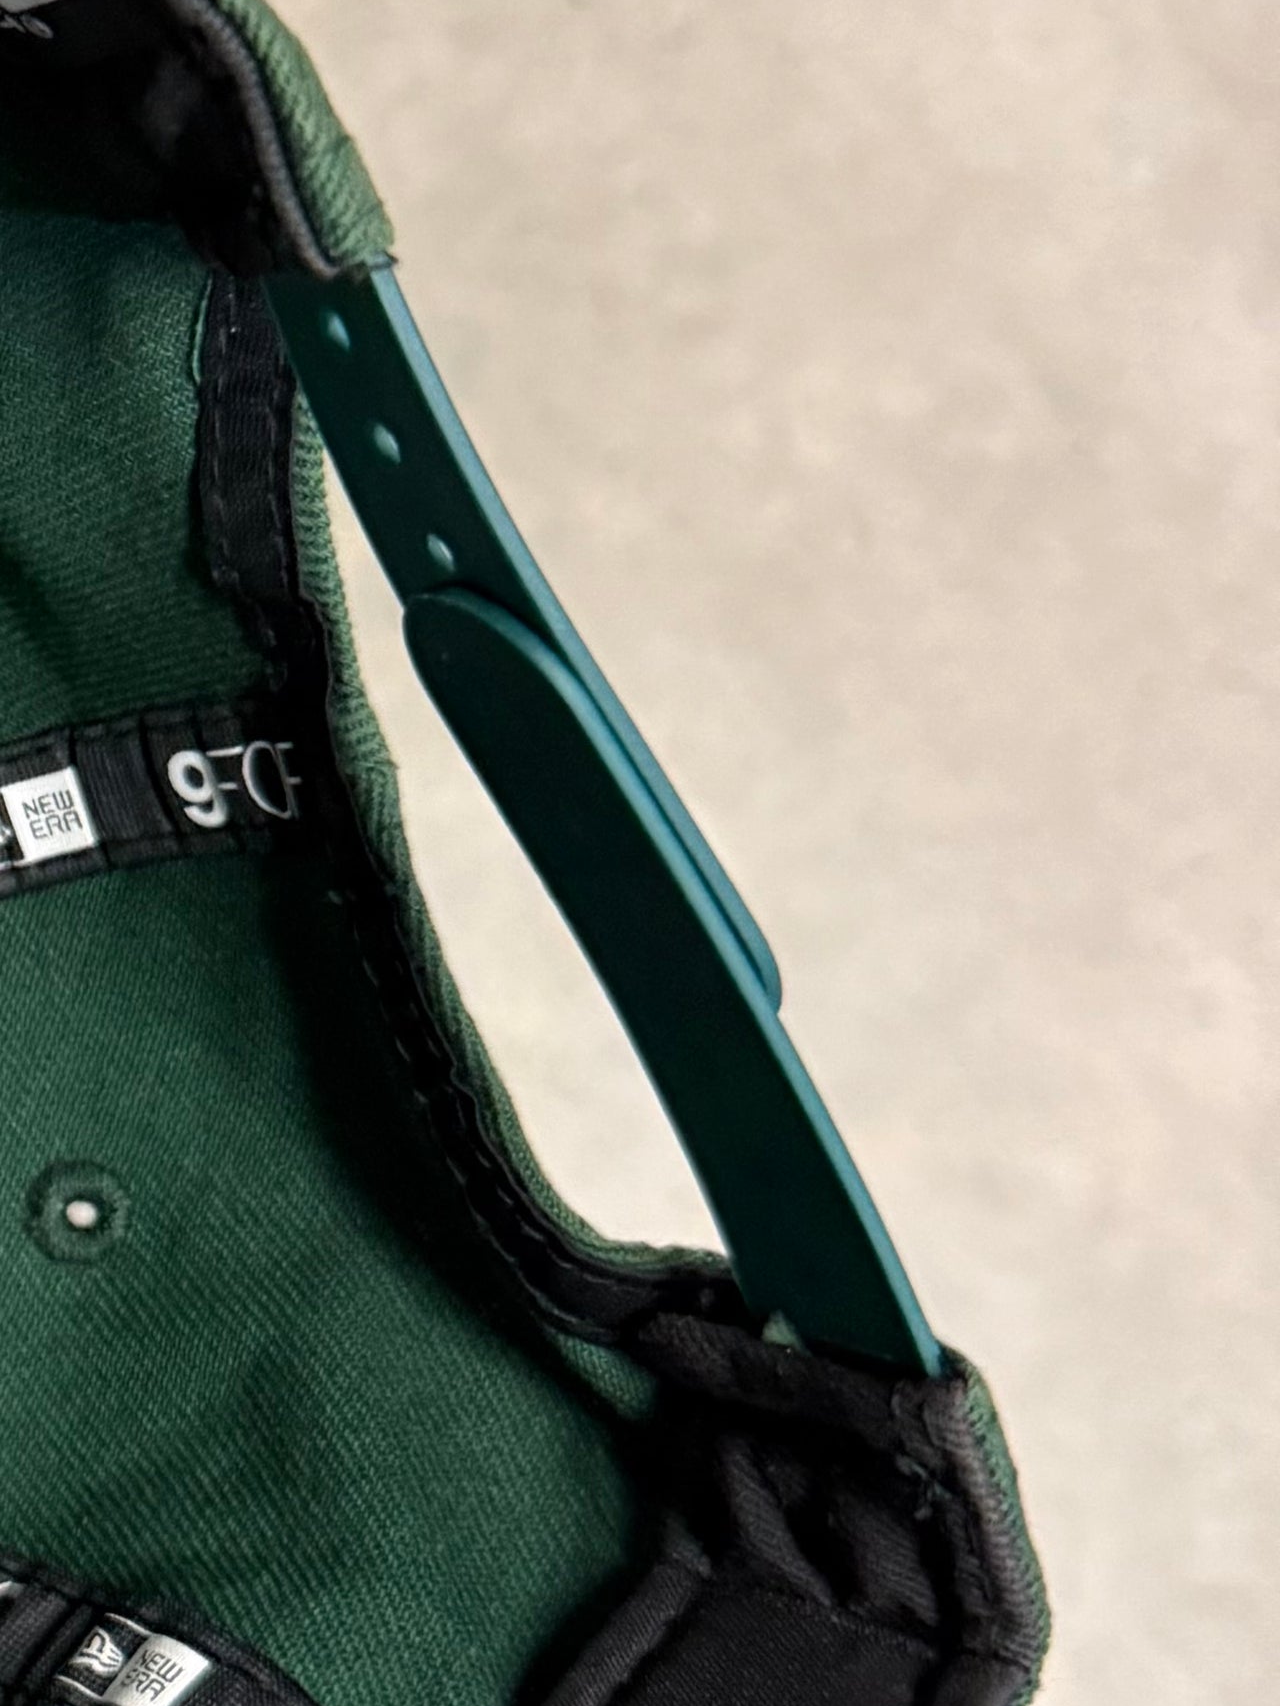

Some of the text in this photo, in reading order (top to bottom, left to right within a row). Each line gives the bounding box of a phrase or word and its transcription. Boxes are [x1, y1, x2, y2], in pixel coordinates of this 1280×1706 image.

[21, 789, 75, 820] NEW
[29, 809, 84, 840] ERA
[141, 1649, 185, 1683] NEW
[121, 1667, 166, 1702] ERA
